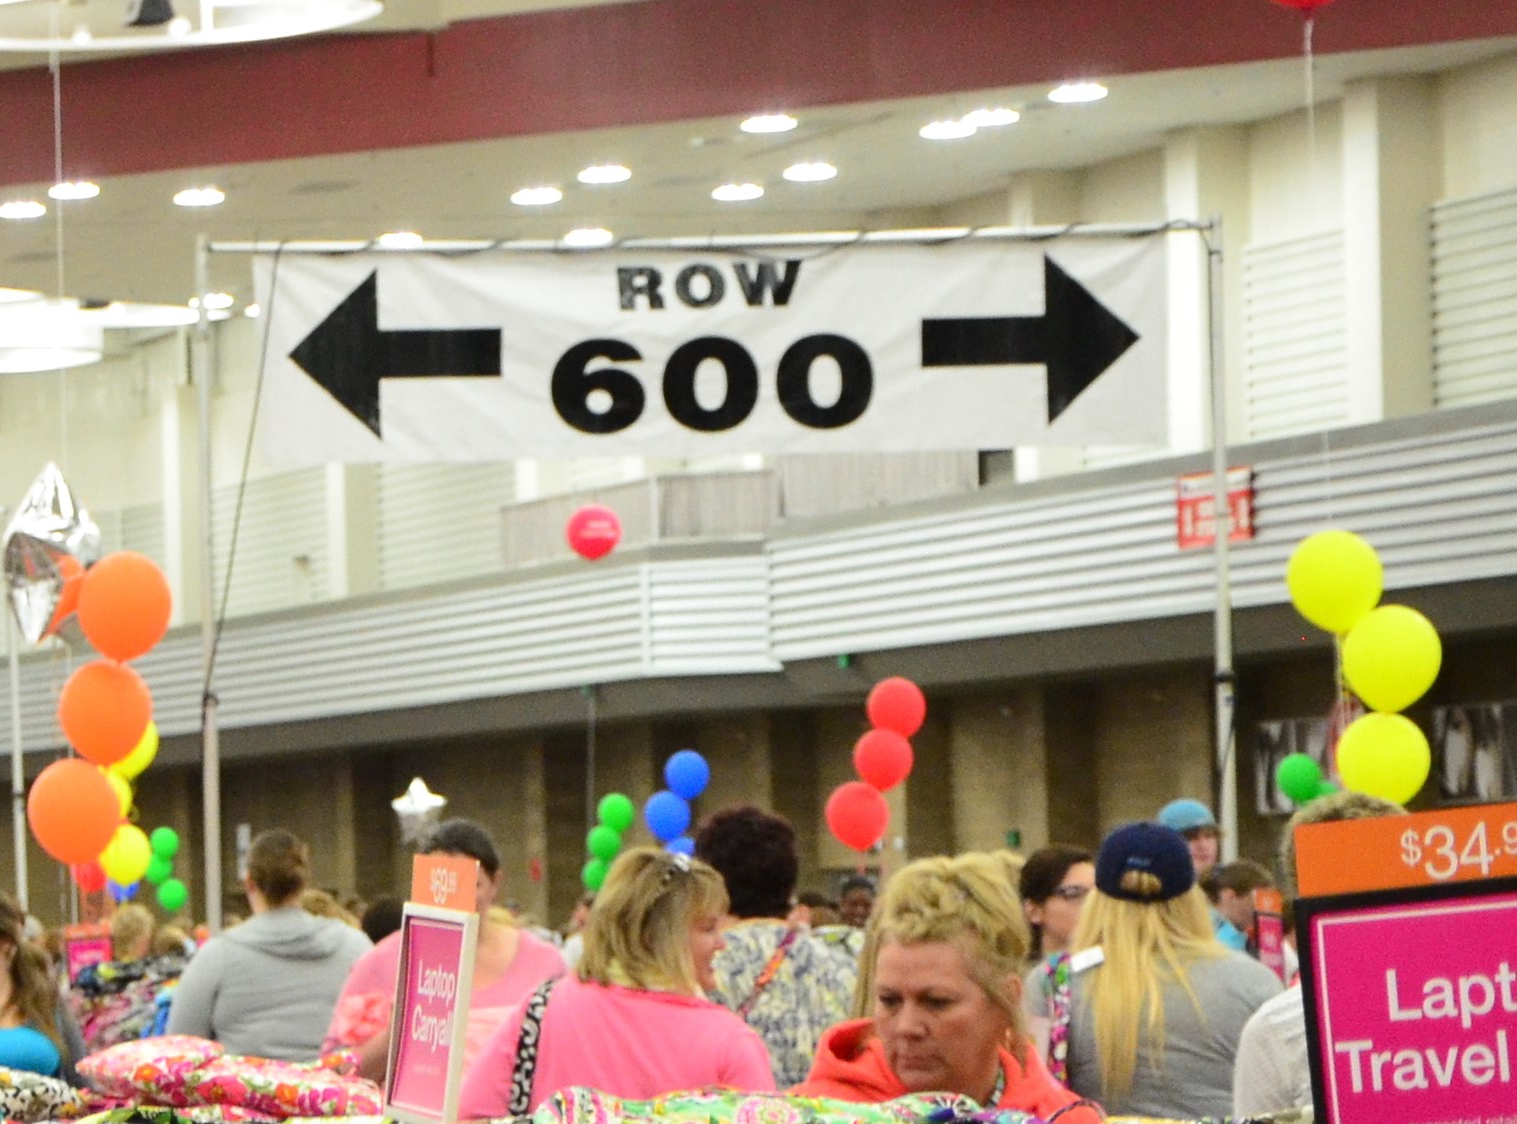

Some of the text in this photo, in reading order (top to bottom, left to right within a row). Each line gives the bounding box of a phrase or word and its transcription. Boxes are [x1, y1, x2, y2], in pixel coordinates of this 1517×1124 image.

[617, 260, 802, 310] ROW
[550, 333, 874, 434] 600
[417, 959, 456, 1008] Laptop
[1334, 1029, 1511, 1093] Travel
